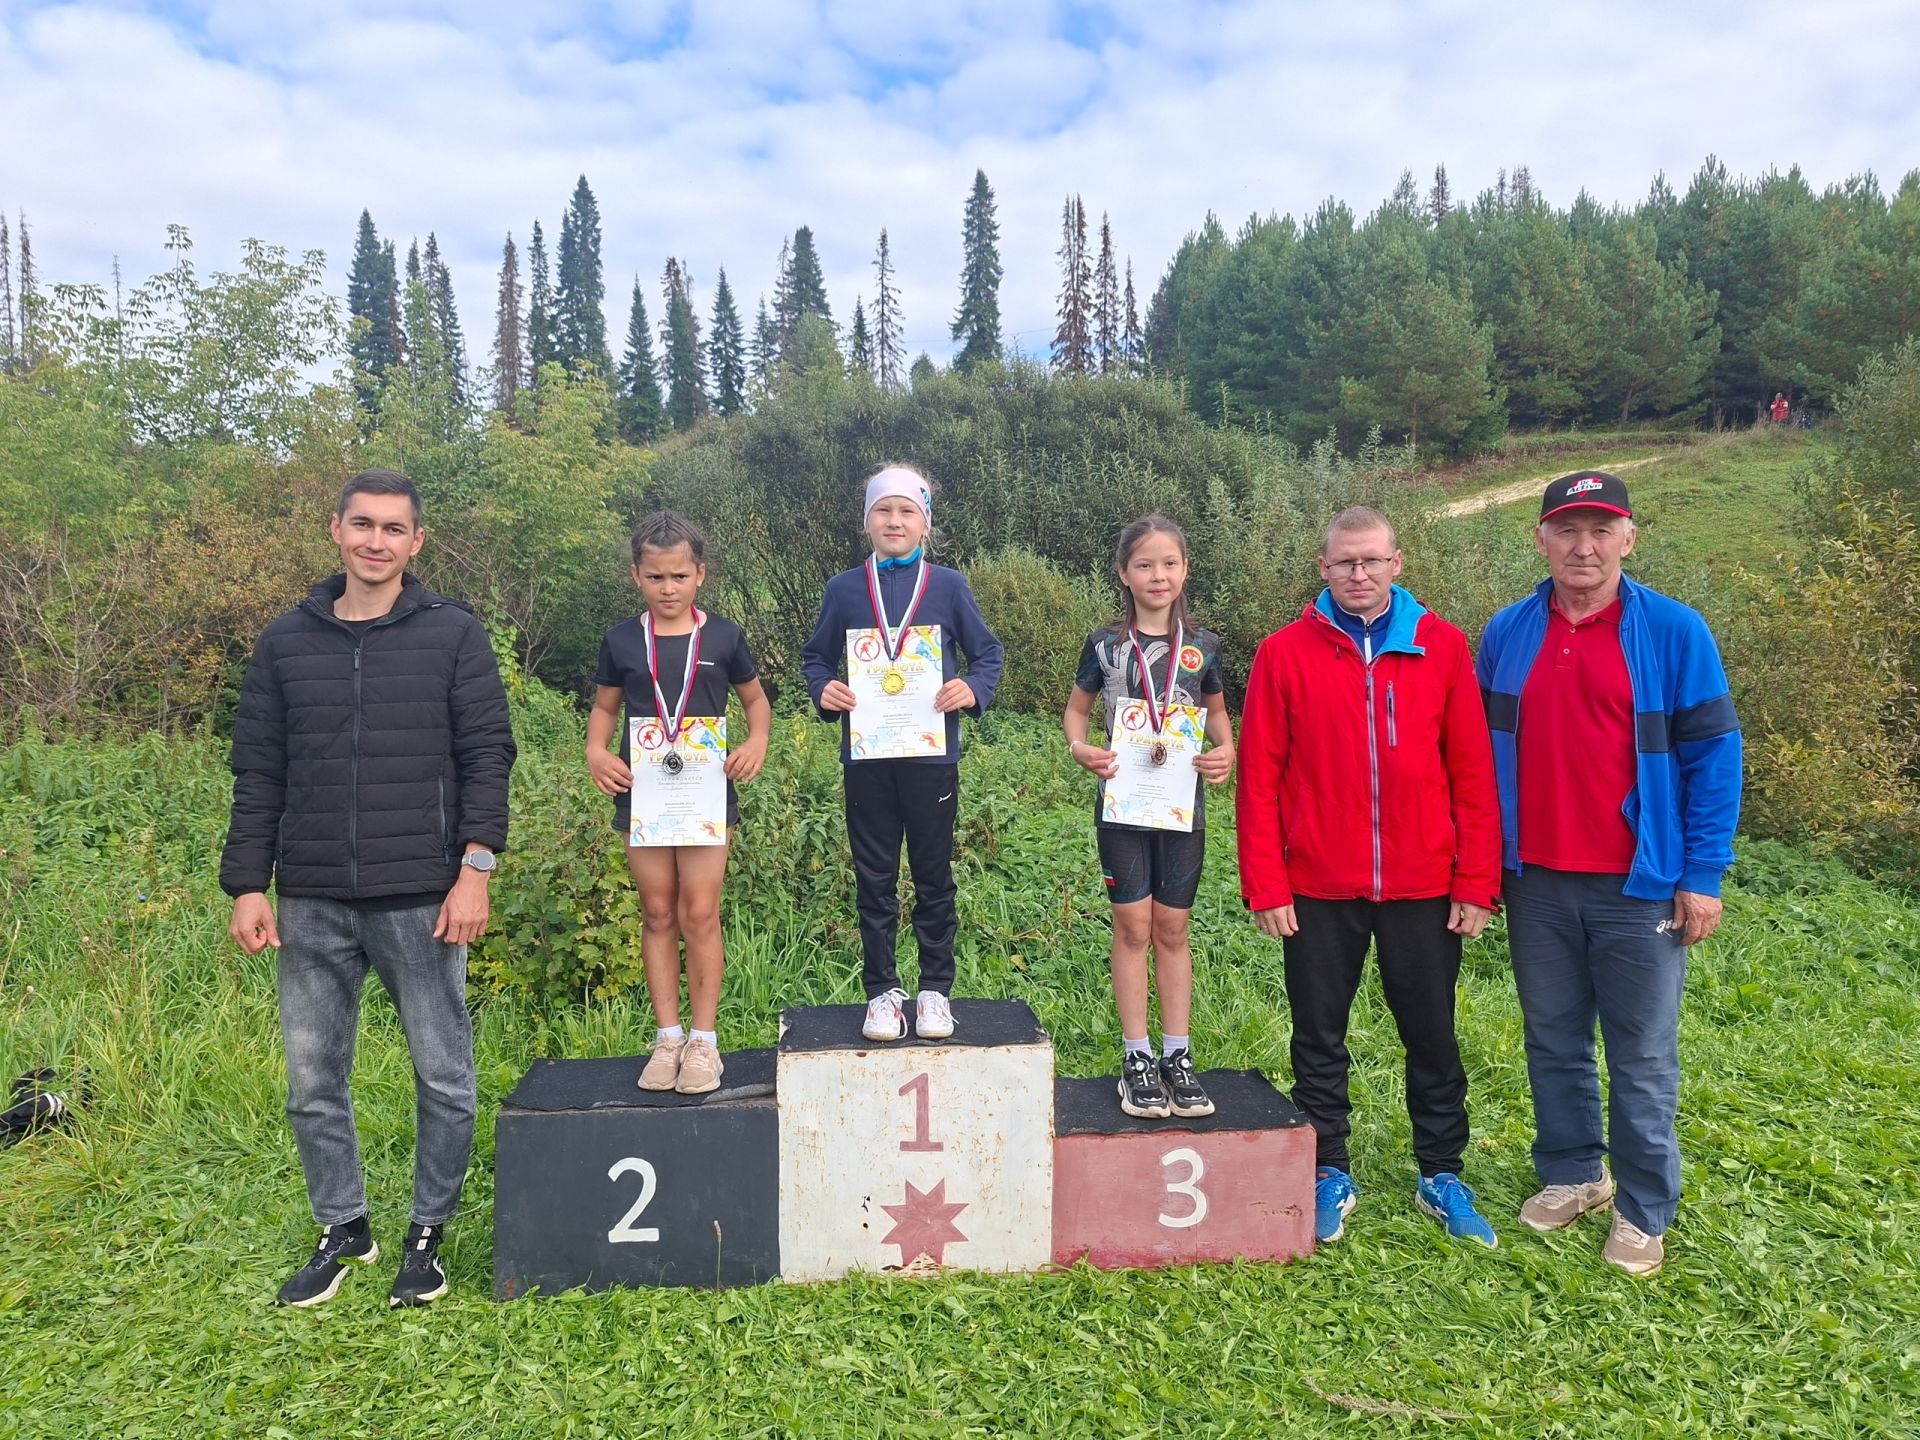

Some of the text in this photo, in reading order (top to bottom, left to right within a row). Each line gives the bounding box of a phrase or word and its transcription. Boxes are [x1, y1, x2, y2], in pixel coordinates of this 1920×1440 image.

[1568, 484, 1601, 494] Active
[649, 752, 708, 761] ГРОТА
[898, 1072, 944, 1152] 1
[607, 1157, 660, 1243] 2
[1158, 1147, 1207, 1228] 3
